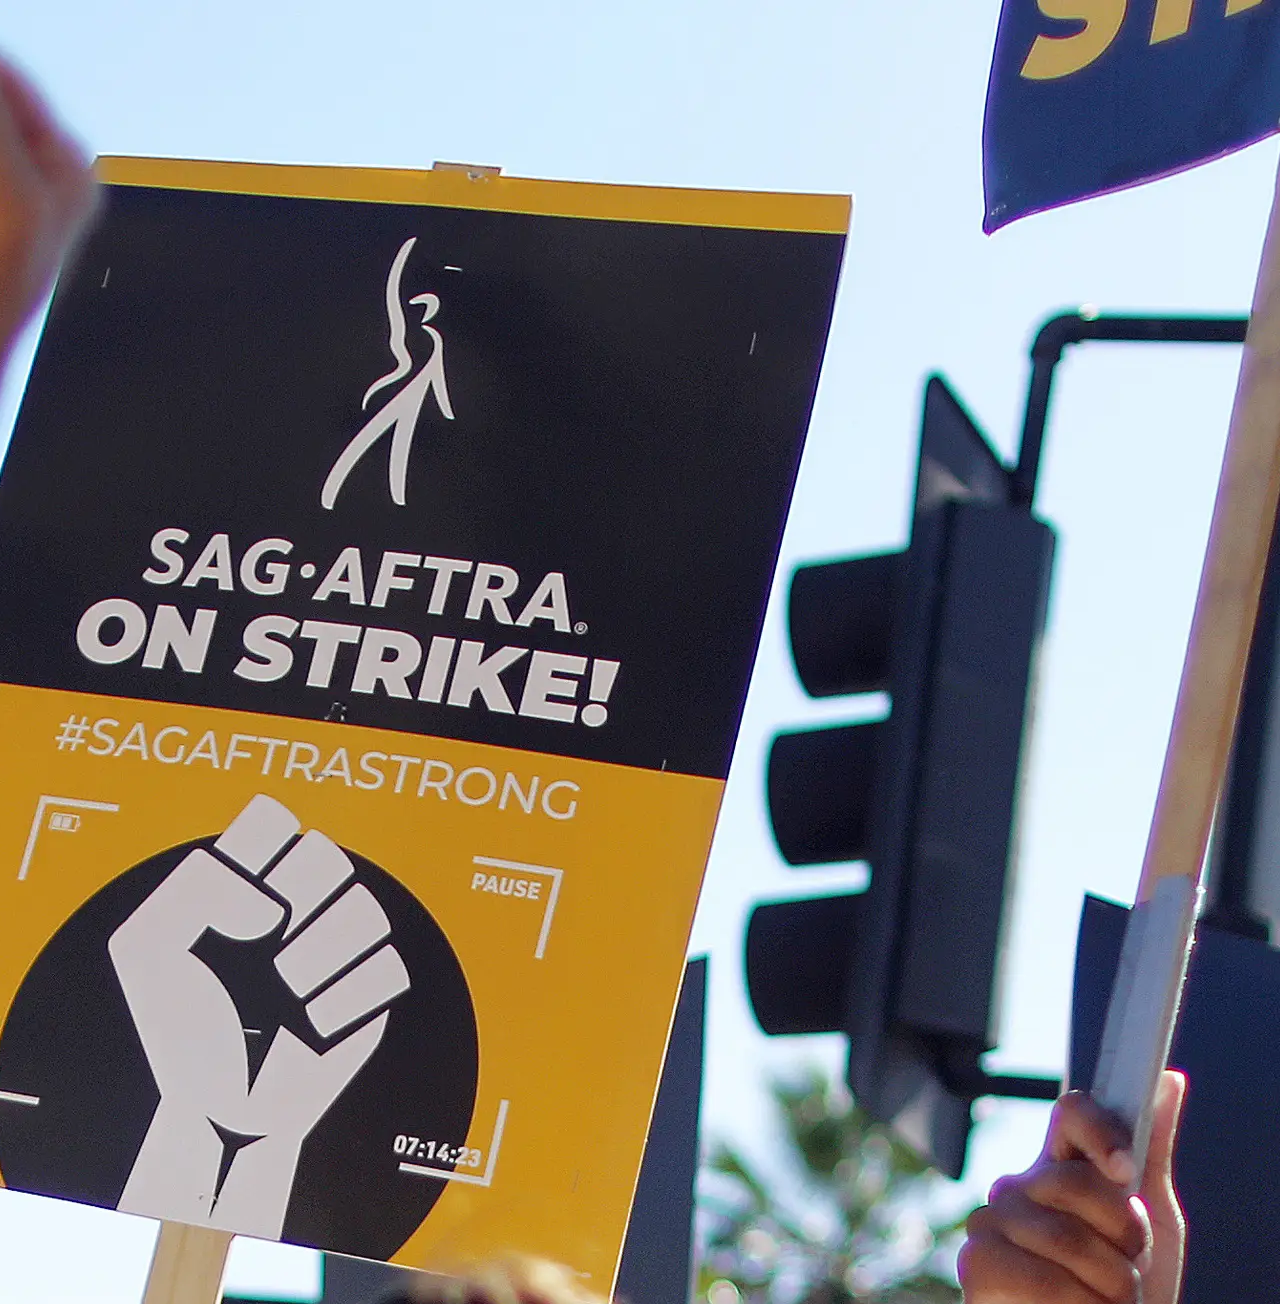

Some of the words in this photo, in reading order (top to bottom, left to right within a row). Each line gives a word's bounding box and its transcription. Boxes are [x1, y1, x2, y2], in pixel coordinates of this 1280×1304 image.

[75, 598, 217, 674] ON
[233, 614, 620, 727] STRIKE!
[55, 714, 582, 821] #SAGAFTRASTRONG
[471, 872, 542, 900] PAUSE
[393, 1134, 482, 1168] 07:14:23
